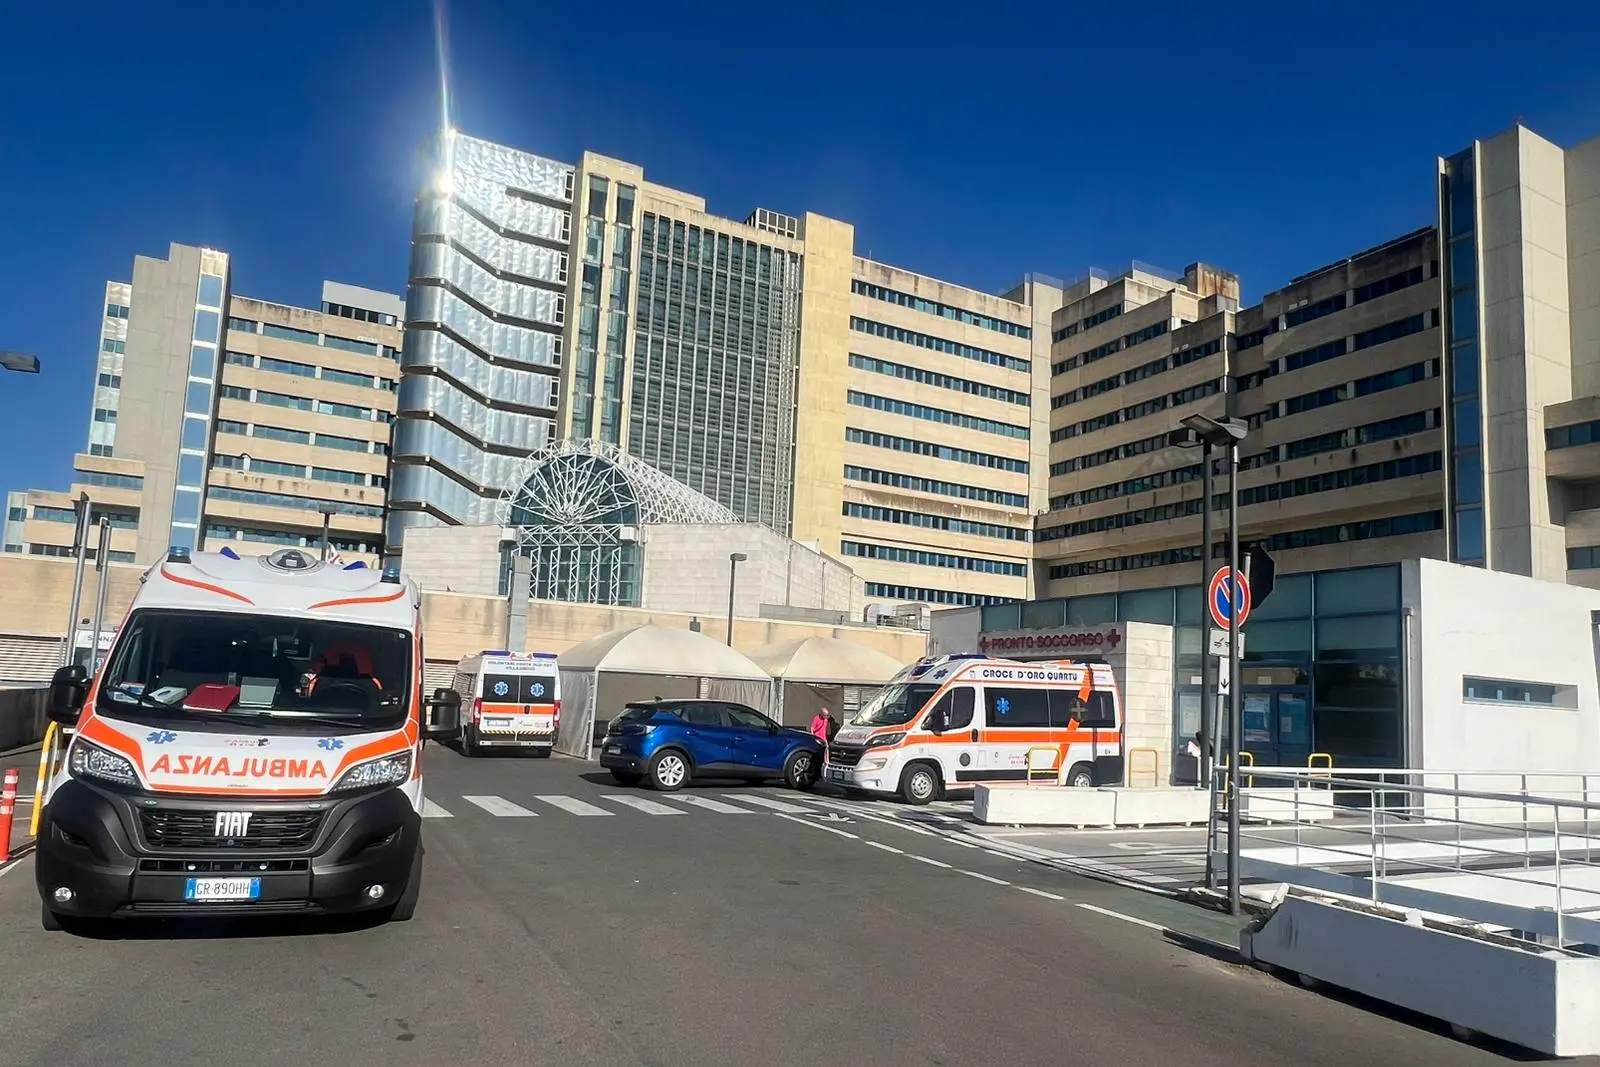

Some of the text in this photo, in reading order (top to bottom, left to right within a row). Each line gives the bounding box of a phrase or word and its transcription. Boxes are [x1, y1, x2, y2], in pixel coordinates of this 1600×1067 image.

[991, 632, 1104, 649] PRONTO SOCCORSO
[982, 669, 1078, 681] CROCE D'ORO QUARTU
[214, 811, 253, 837] FIAT
